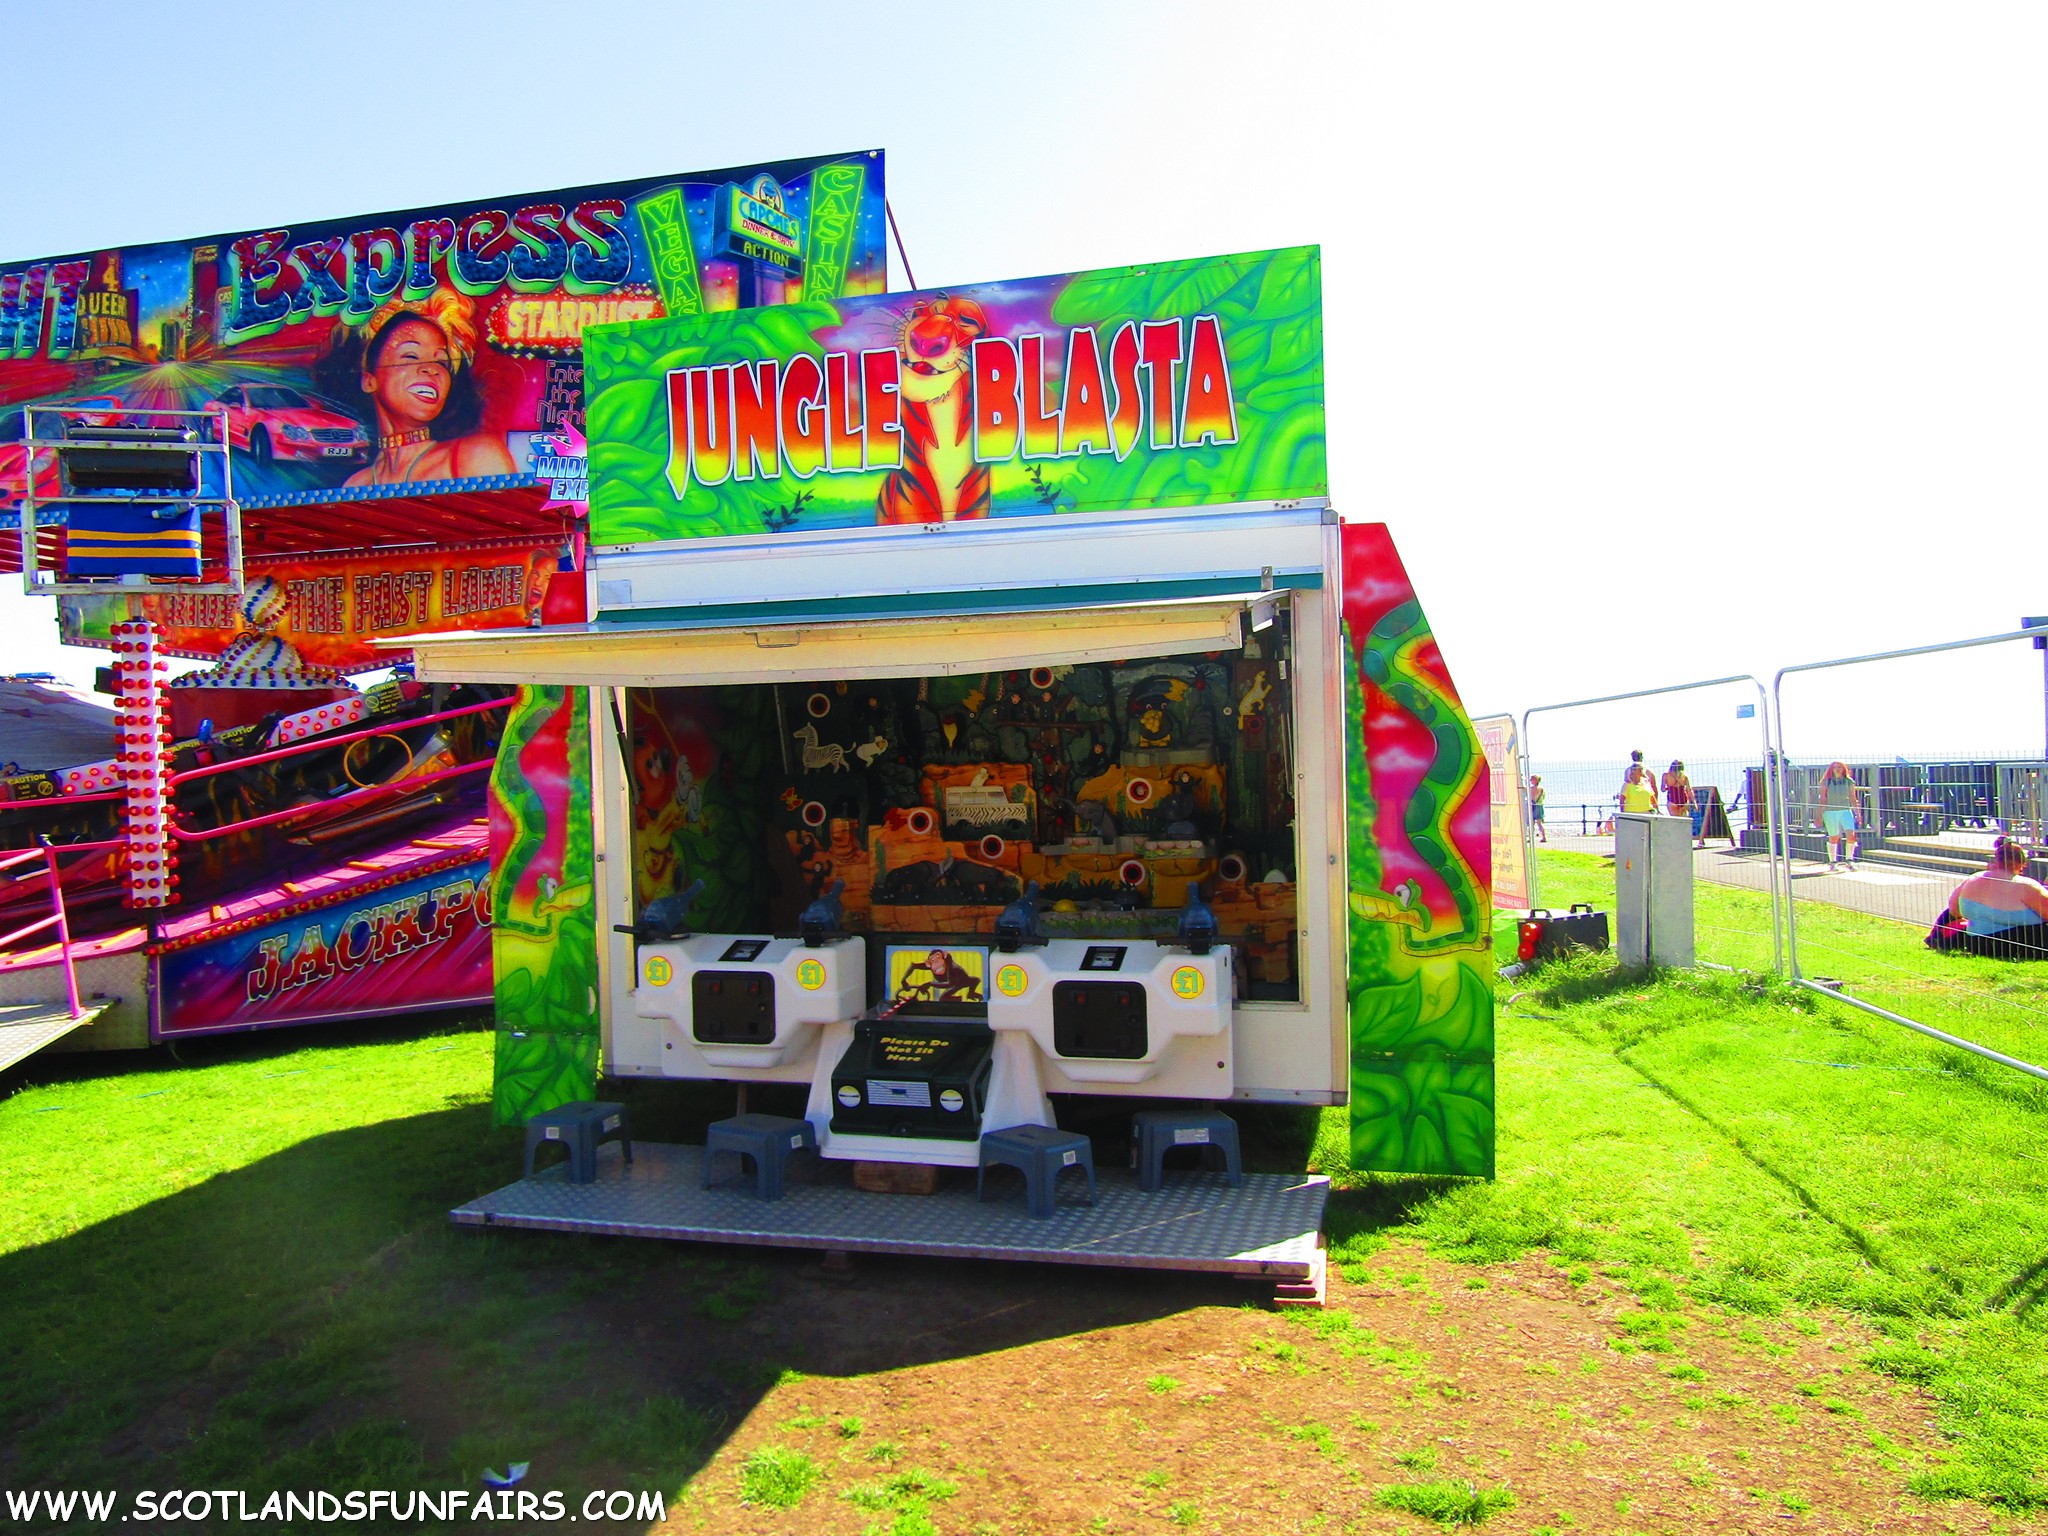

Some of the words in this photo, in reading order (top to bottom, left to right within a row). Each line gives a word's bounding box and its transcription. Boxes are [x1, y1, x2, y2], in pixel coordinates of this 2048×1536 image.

[741, 219, 769, 238] DINNER
[770, 233, 777, 241] &
[777, 237, 796, 249] SHOW
[743, 241, 790, 267] ACTION
[551, 379, 582, 403] the
[664, 346, 905, 501] JUNGLE
[971, 315, 1239, 463] BLASTA
[327, 447, 349, 455] RJJ
[167, 594, 236, 628] RIDE
[287, 576, 344, 634] THE
[353, 571, 433, 633] FAST
[442, 565, 523, 618] LANE
[7, 774, 46, 785] CAUTION
[650, 960, 669, 982] £1
[801, 963, 821, 985] £1
[1001, 967, 1023, 991] £1
[1176, 969, 1199, 993] £1
[880, 1037, 927, 1046] Please
[884, 1046, 912, 1054] Not
[887, 1054, 922, 1062] Here
